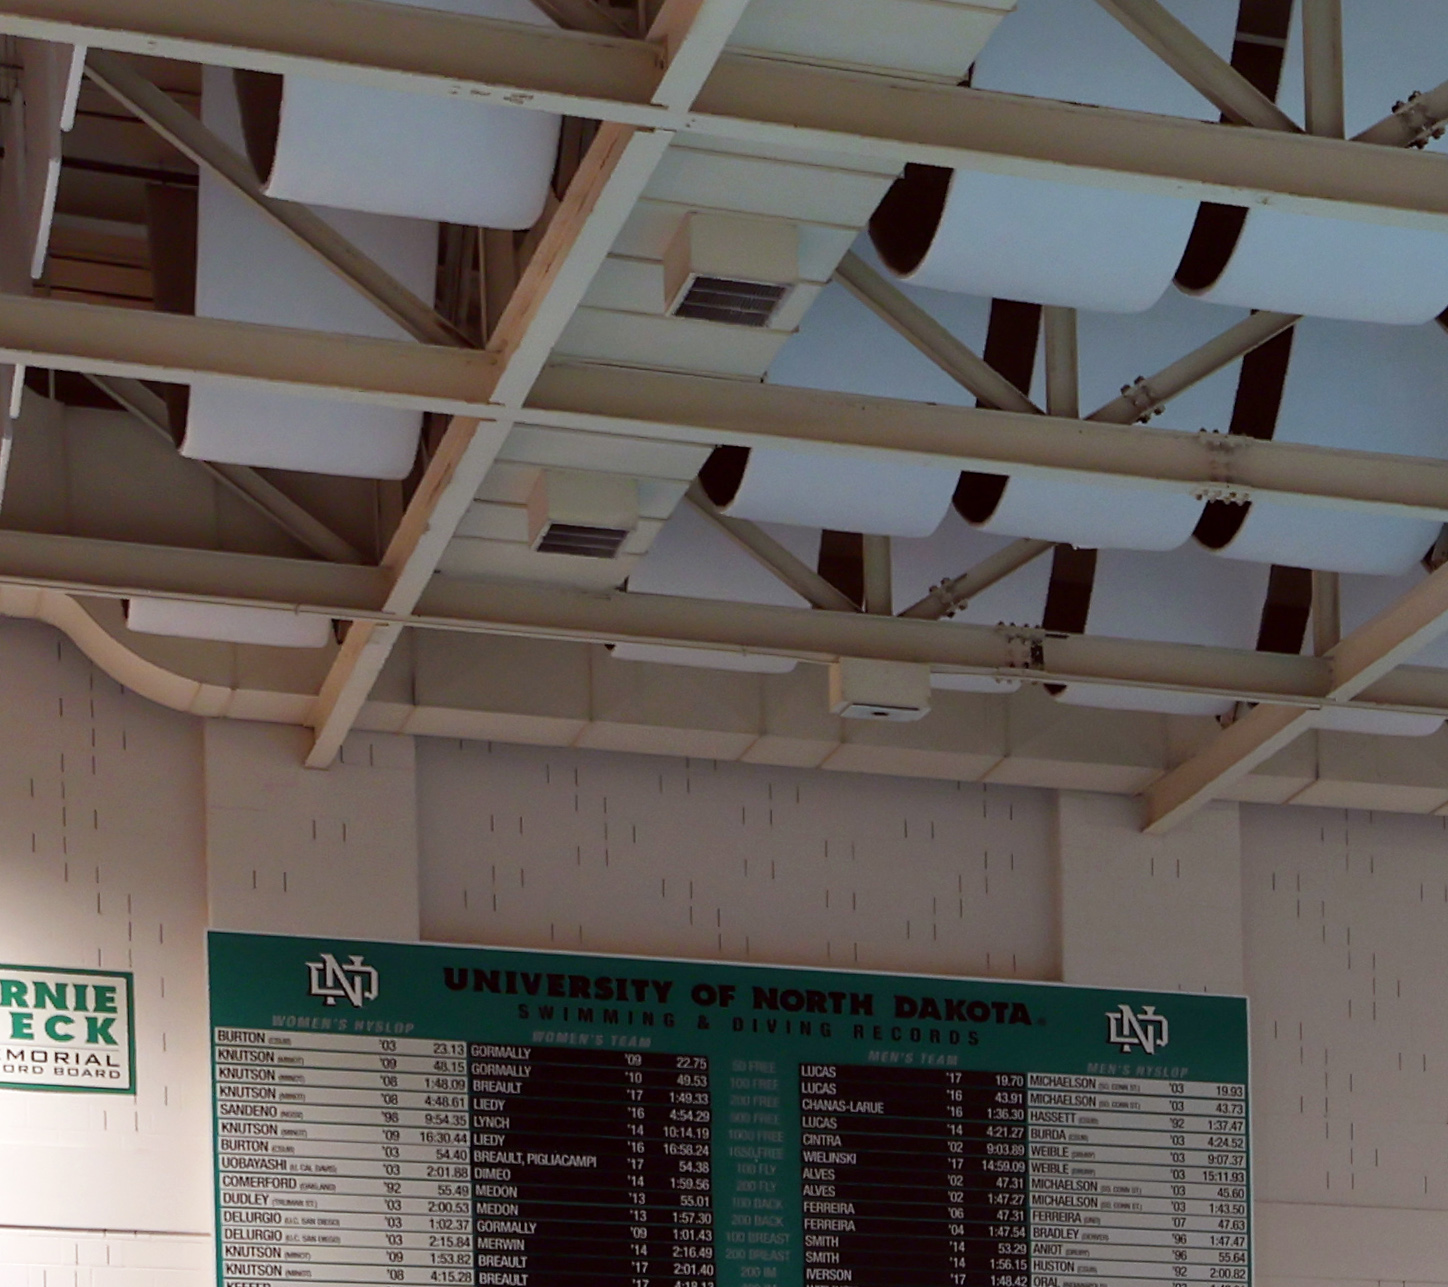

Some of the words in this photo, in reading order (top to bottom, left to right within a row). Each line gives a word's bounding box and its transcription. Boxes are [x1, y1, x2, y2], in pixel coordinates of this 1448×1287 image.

[0, 981, 118, 1014] RNIE
[443, 966, 674, 1004] UNIVERSITY
[692, 981, 737, 1008] OF
[753, 984, 873, 1018] NORTH
[893, 995, 1031, 1026] DAKOTA
[10, 1013, 118, 1045] ECK
[518, 1003, 675, 1028] SWIMMING
[697, 1016, 710, 1032] &
[732, 1017, 833, 1037] DIVING
[854, 1024, 982, 1046] RECORDS
[218, 1030, 265, 1043] BURTON
[434, 1043, 464, 1055] 23.13
[0, 1049, 120, 1068] MORIAL
[218, 1049, 274, 1063] KNUTSON
[471, 1045, 531, 1059] GORMALLY
[677, 1057, 707, 1069] 22.75
[53, 1067, 121, 1080] BOARD
[801, 1065, 836, 1078] LUCAS
[995, 1074, 1023, 1087] 19.70
[473, 1080, 522, 1094] BREAULT
[1030, 1075, 1096, 1089] MICHAELSON
[1216, 1086, 1243, 1097] 19.93
[220, 1104, 277, 1118] SANDENO
[802, 1099, 884, 1114] CHANAS-LARUE
[222, 1158, 287, 1171] UOBAYASHI
[223, 1176, 297, 1189] COMERFORD
